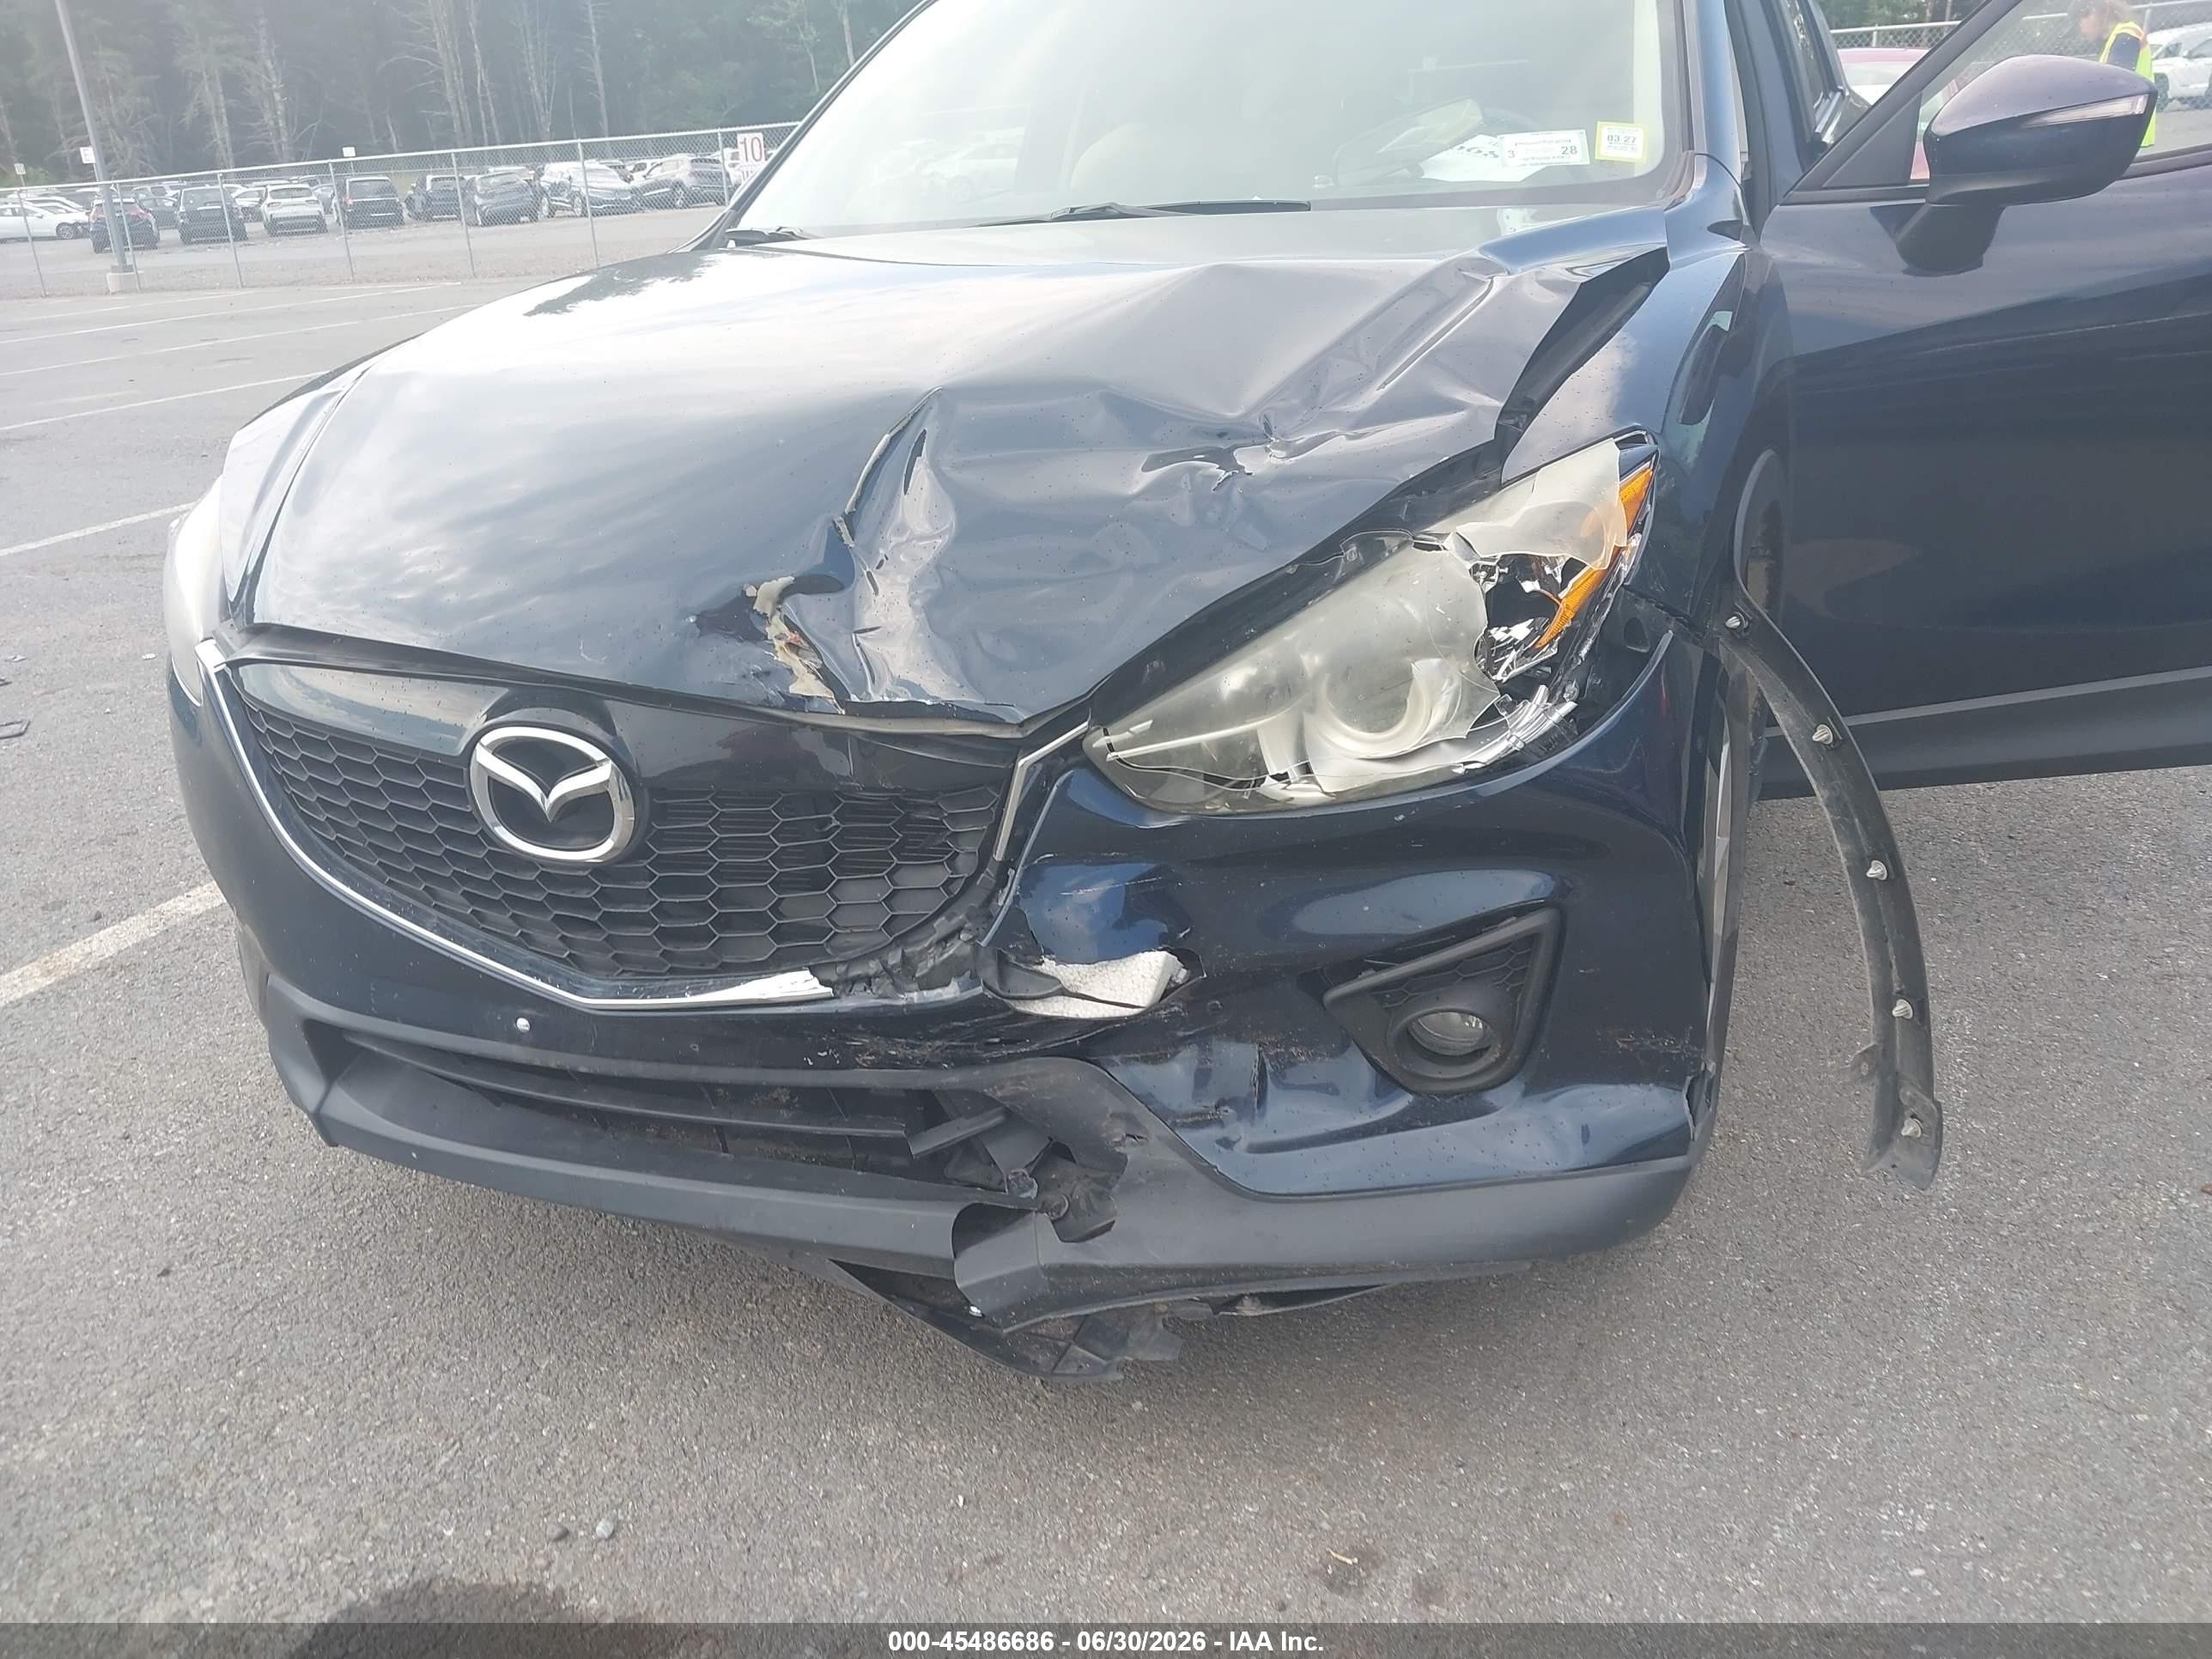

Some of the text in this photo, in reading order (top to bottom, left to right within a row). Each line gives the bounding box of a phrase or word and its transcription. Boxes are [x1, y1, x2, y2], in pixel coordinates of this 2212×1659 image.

[1607, 134, 1637, 144] 03 27
[739, 137, 763, 162] 10
[1507, 149, 1516, 159] 3
[1560, 145, 1578, 155] 28
